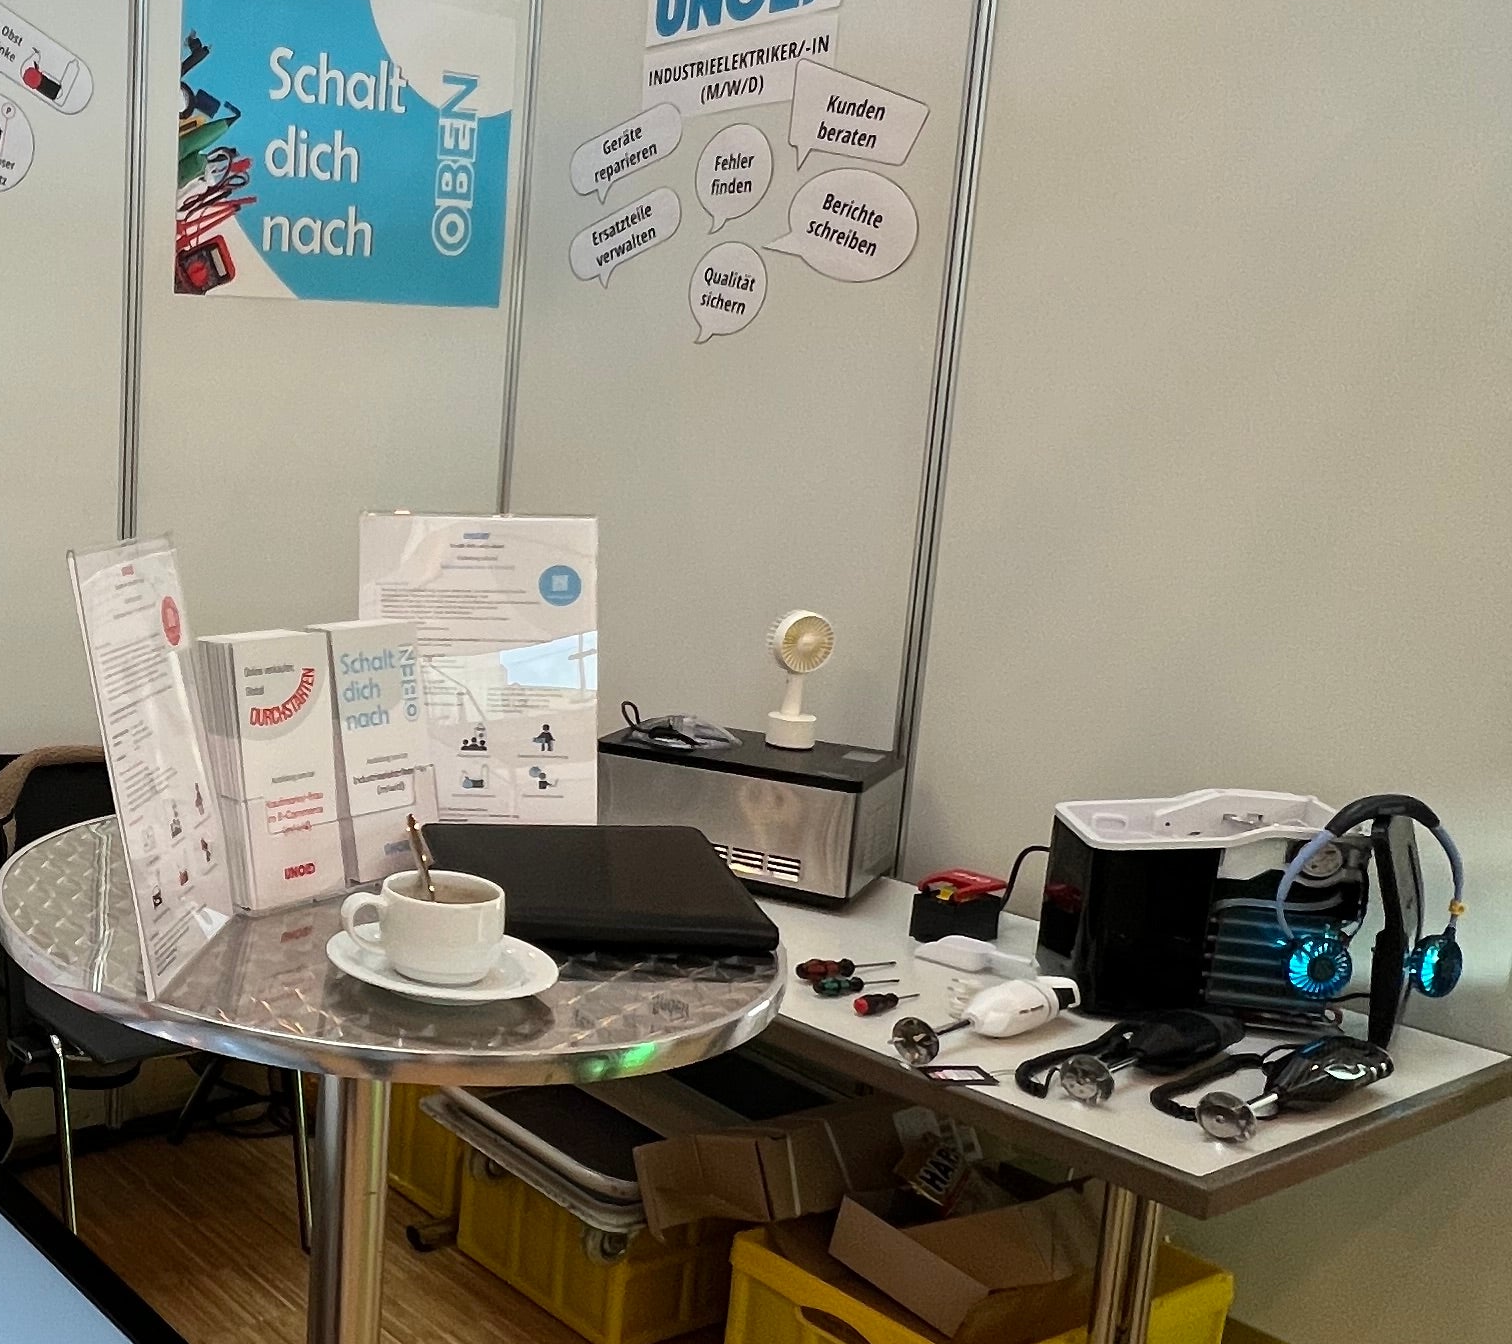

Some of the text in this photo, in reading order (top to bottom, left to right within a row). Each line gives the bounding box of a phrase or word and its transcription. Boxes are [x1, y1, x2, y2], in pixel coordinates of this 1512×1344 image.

[1, 25, 24, 47] Obst
[648, 34, 831, 87] INDUSTRIEELEKTRIKER/-IN
[267, 46, 409, 114] Schalt
[700, 75, 765, 105] (M/W/D)
[826, 94, 887, 125] Kunden
[602, 125, 643, 156] Geräte
[817, 121, 878, 149] beraten
[264, 125, 359, 183] dich
[431, 70, 480, 256] OBEN
[594, 143, 658, 184] reparieren
[714, 153, 755, 172] Fehler
[711, 178, 753, 196] finden
[591, 204, 653, 247] Ersatzteile
[822, 193, 884, 229] Berichte
[262, 205, 373, 257] nach
[596, 226, 657, 267] verwalten
[806, 218, 878, 258] schreiben
[703, 266, 756, 293] Qualität
[700, 291, 746, 316] sichern
[340, 649, 396, 675] Schalt
[249, 667, 315, 726] DURCHSTARTEN
[343, 678, 381, 703] dich
[346, 704, 390, 731] nach
